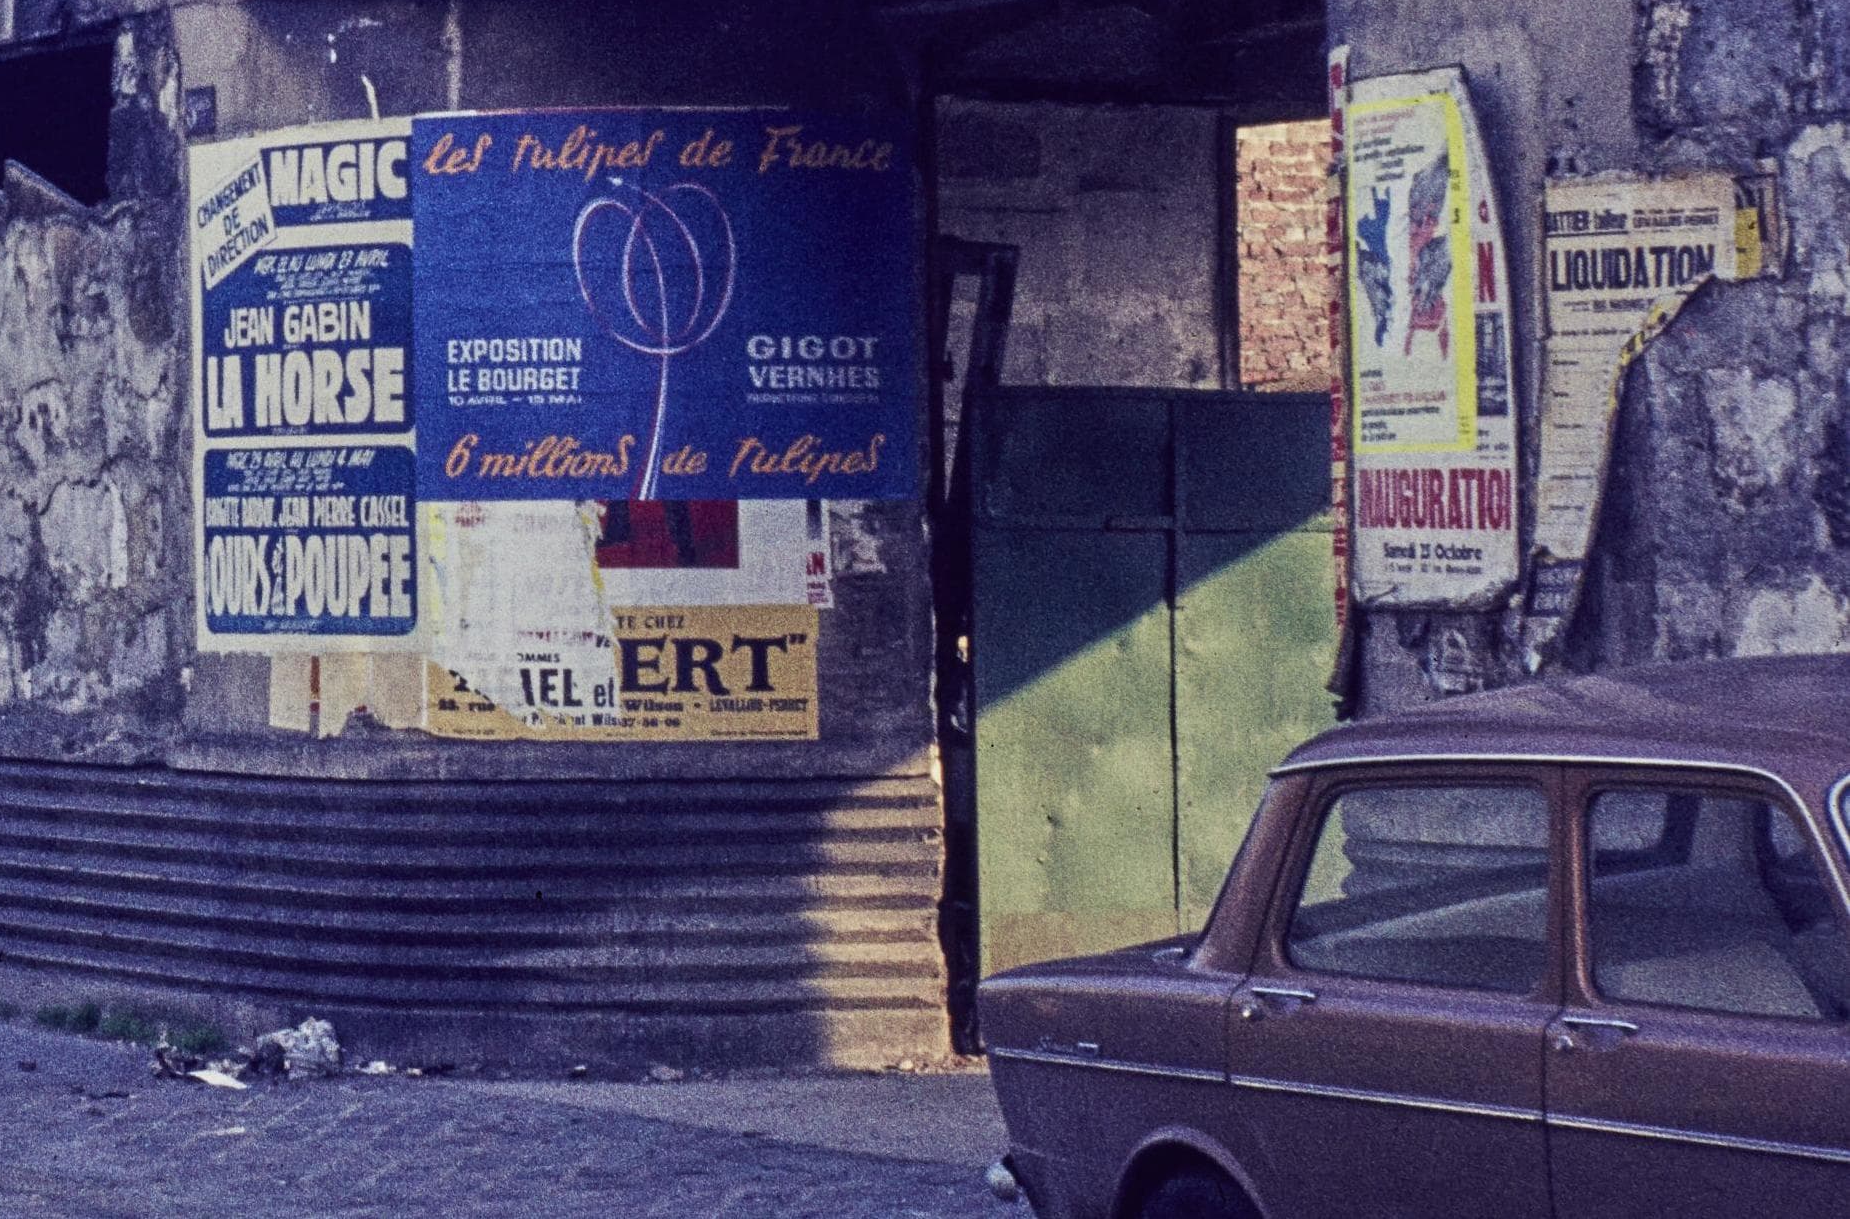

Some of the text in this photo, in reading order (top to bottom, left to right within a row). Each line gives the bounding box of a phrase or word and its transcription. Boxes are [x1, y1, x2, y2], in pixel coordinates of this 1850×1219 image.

[679, 127, 734, 168] de
[758, 124, 895, 175] France
[269, 140, 409, 208] MAGIC
[223, 206, 242, 236] DE
[206, 213, 270, 278] DIRECTION
[1551, 244, 1715, 292] LIQUIDATION
[224, 300, 371, 349] JEAN GABIN
[447, 337, 582, 364] EXPOSITION
[746, 334, 880, 361] GIGOT
[207, 346, 405, 430] LA HORSE
[447, 366, 581, 392] LE BOURGET
[748, 365, 880, 389] VERNHES
[445, 433, 479, 479] 6
[479, 433, 636, 478] millions
[661, 444, 709, 475] de
[278, 496, 310, 527] JEAN
[313, 495, 356, 527] PIERRE
[360, 494, 410, 528] CASSEL
[1434, 542, 1483, 561] Octobre
[644, 615, 685, 629] CHEZ
